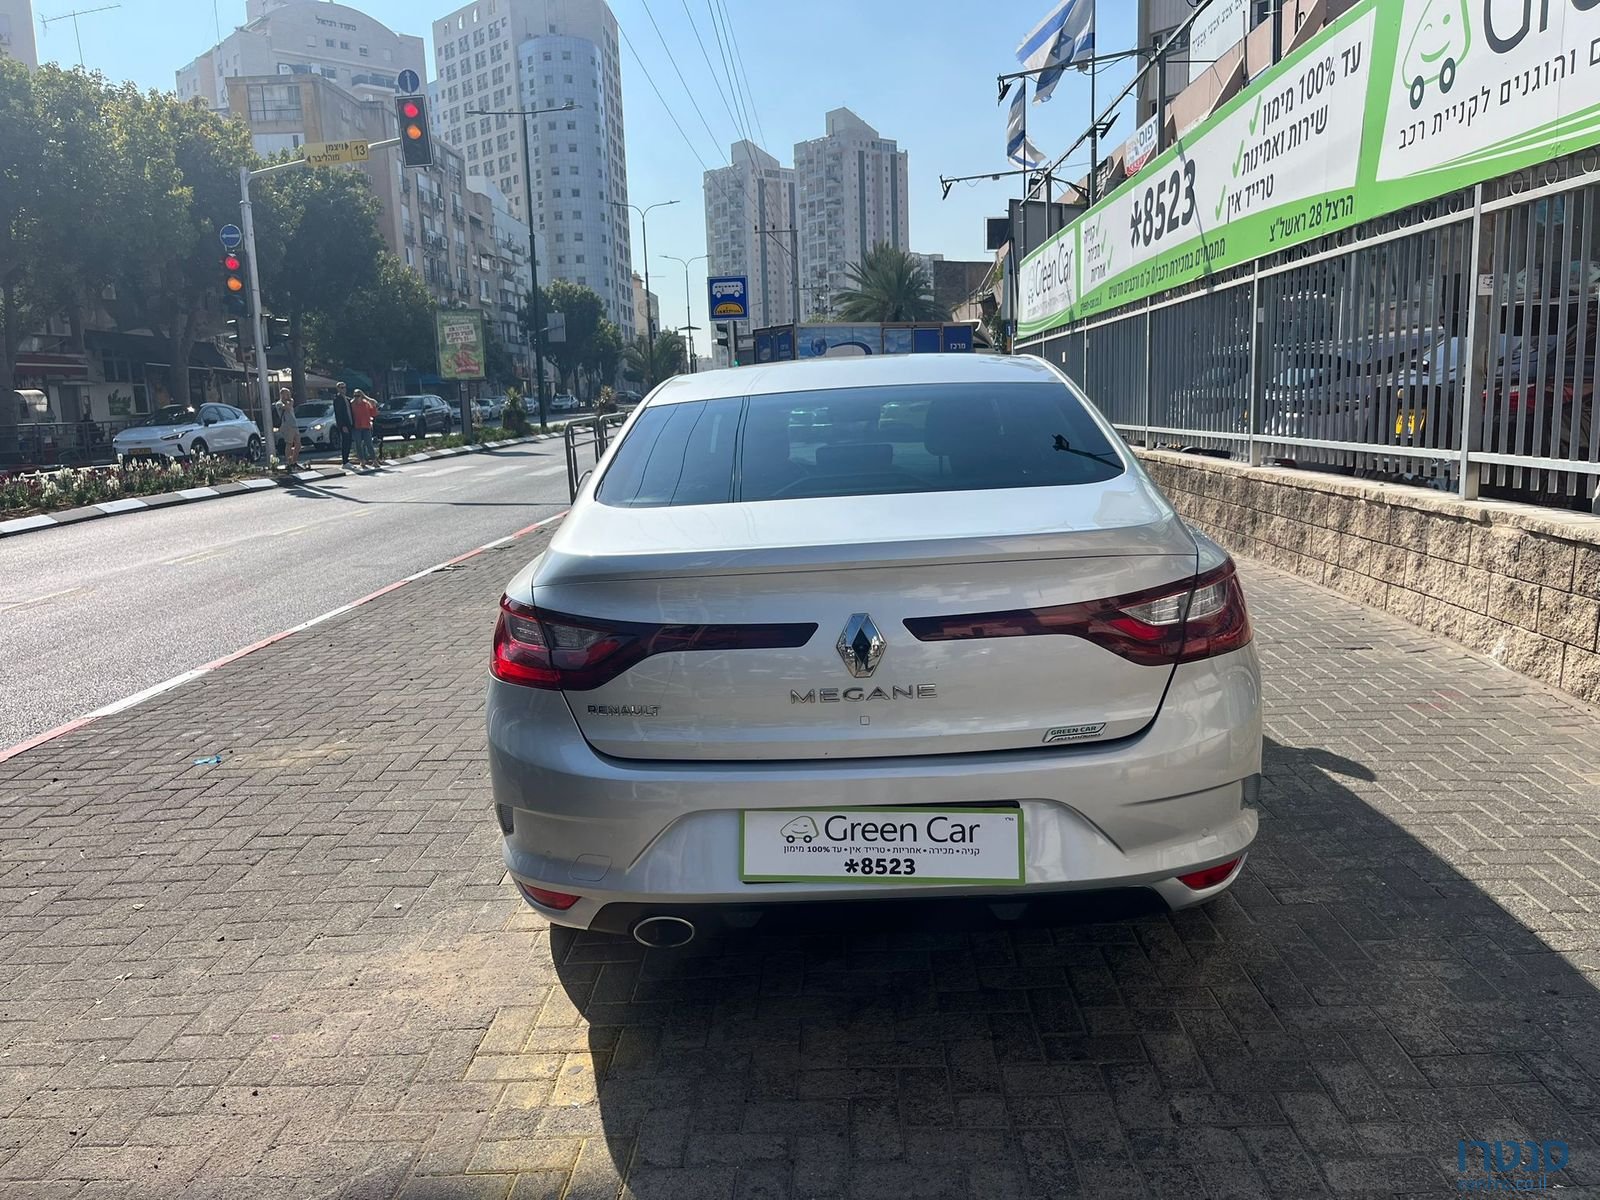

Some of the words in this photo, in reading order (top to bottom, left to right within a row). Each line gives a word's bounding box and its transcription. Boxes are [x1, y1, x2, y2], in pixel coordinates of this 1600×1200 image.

[1341, 41, 1362, 77] עד
[1299, 56, 1336, 105] 100%
[1500, 49, 1576, 106] והוגנים
[1262, 87, 1294, 136] מימון
[1432, 85, 1491, 135] לקניית
[1288, 104, 1329, 151] שירות
[1399, 120, 1425, 150] רכב
[325, 143, 344, 153] ויצמן
[354, 144, 366, 156] 13
[1241, 131, 1285, 176] ואמינות
[1245, 173, 1274, 208] טרייד
[1226, 189, 1242, 224] אין
[1309, 202, 1323, 227] 28
[1325, 194, 1354, 222] הרצל
[1169, 252, 1194, 277] במכירת
[790, 683, 937, 704] MEGANE
[587, 704, 662, 717] RENAULT
[1050, 727, 1079, 736] GREEN
[1080, 725, 1097, 733] CAR
[824, 815, 918, 843] Green
[926, 816, 981, 844] Car
[783, 845, 805, 854] מימון
[831, 846, 842, 854] עד
[849, 846, 861, 855] אין
[863, 846, 885, 854] טרייד
[892, 846, 922, 855] אחריות
[928, 846, 954, 855] מכירה
[961, 847, 980, 856] קניה
